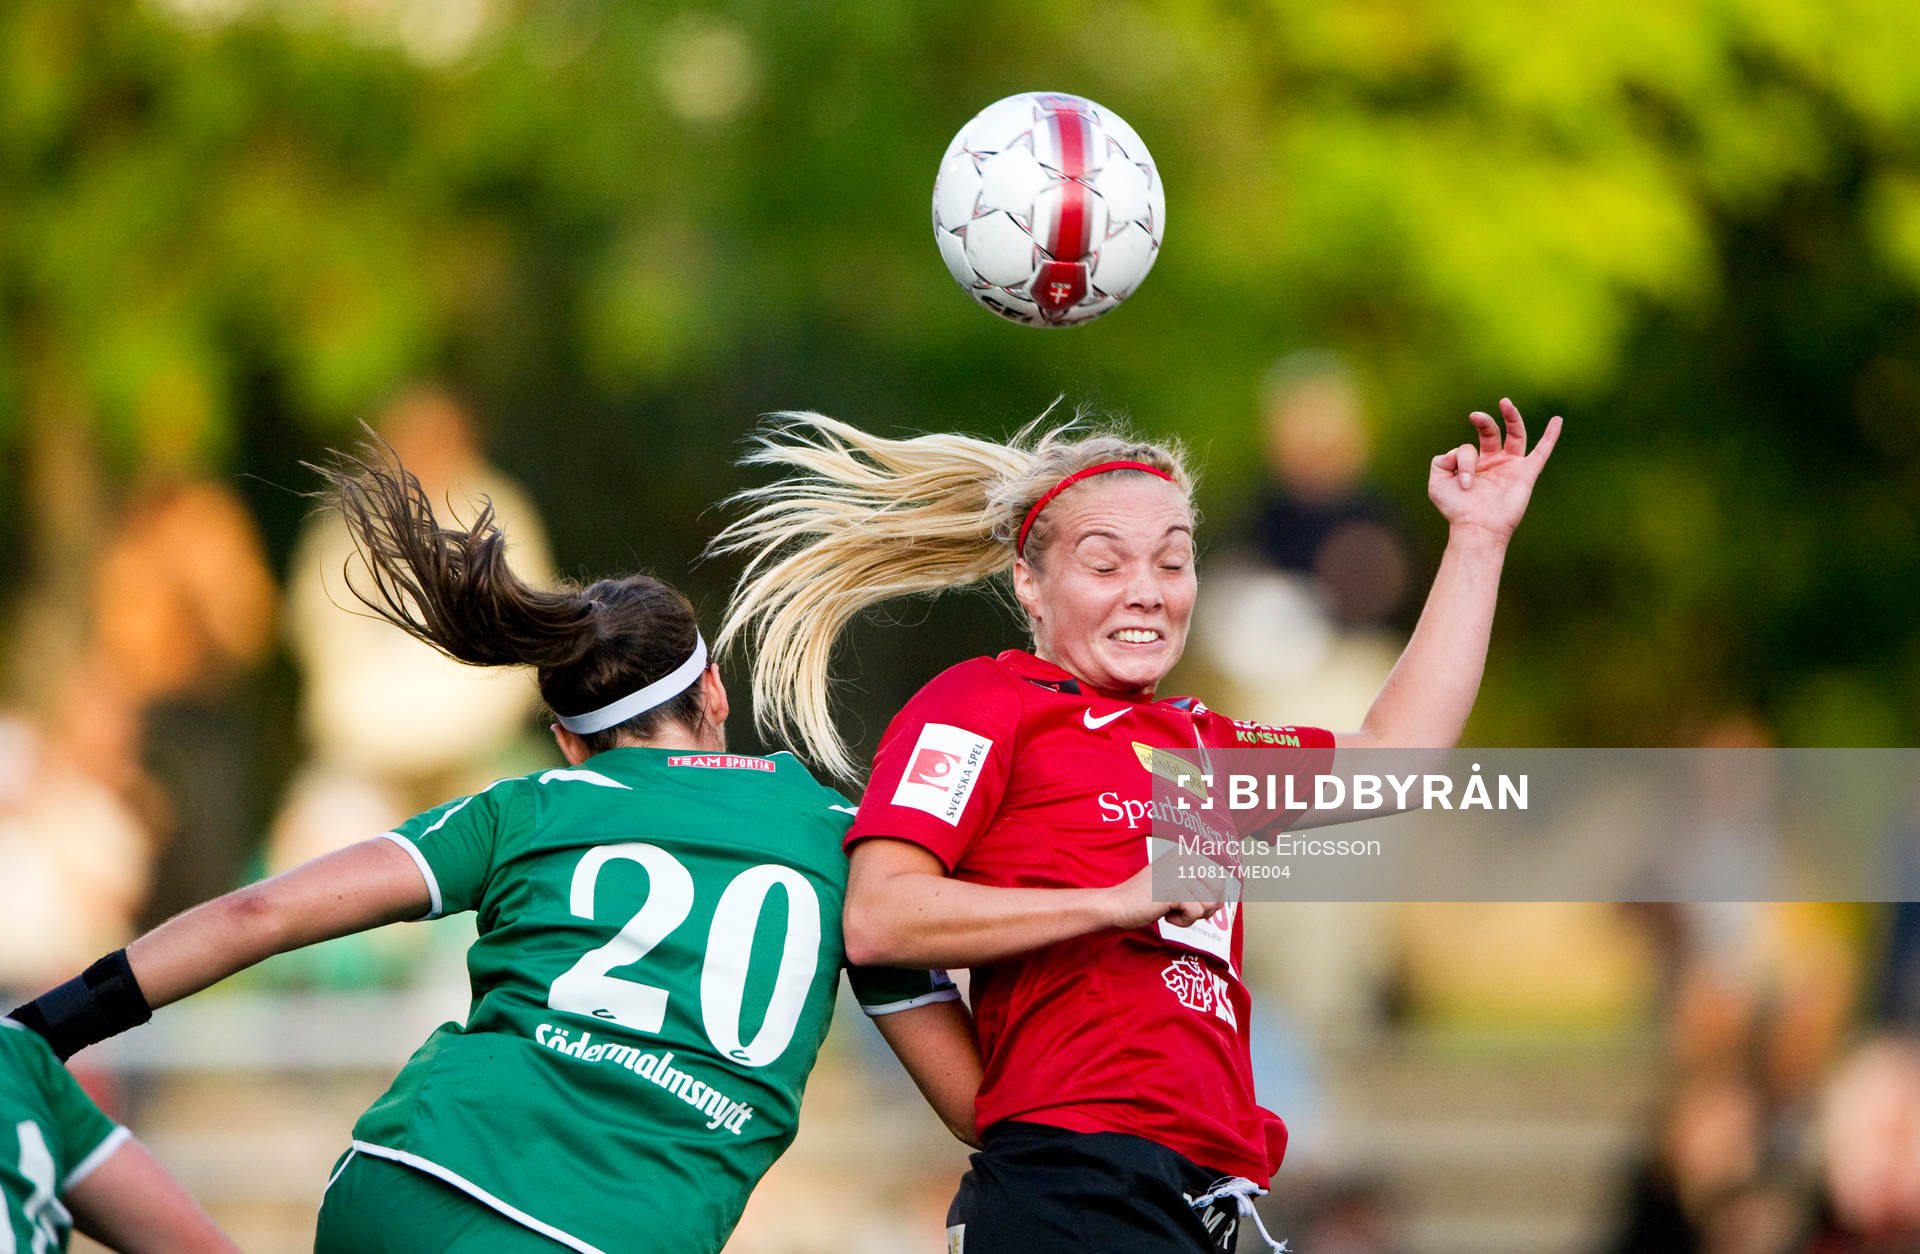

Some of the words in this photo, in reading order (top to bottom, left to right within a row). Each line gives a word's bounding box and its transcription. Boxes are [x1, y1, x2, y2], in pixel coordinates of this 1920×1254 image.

[671, 756, 721, 768] TEAM
[726, 757, 770, 770] SPORTIA
[946, 770, 973, 818] SVENSKA
[967, 743, 985, 767] SPEL
[548, 843, 821, 1067] 20
[535, 1023, 753, 1135] Södermalmsnytt
